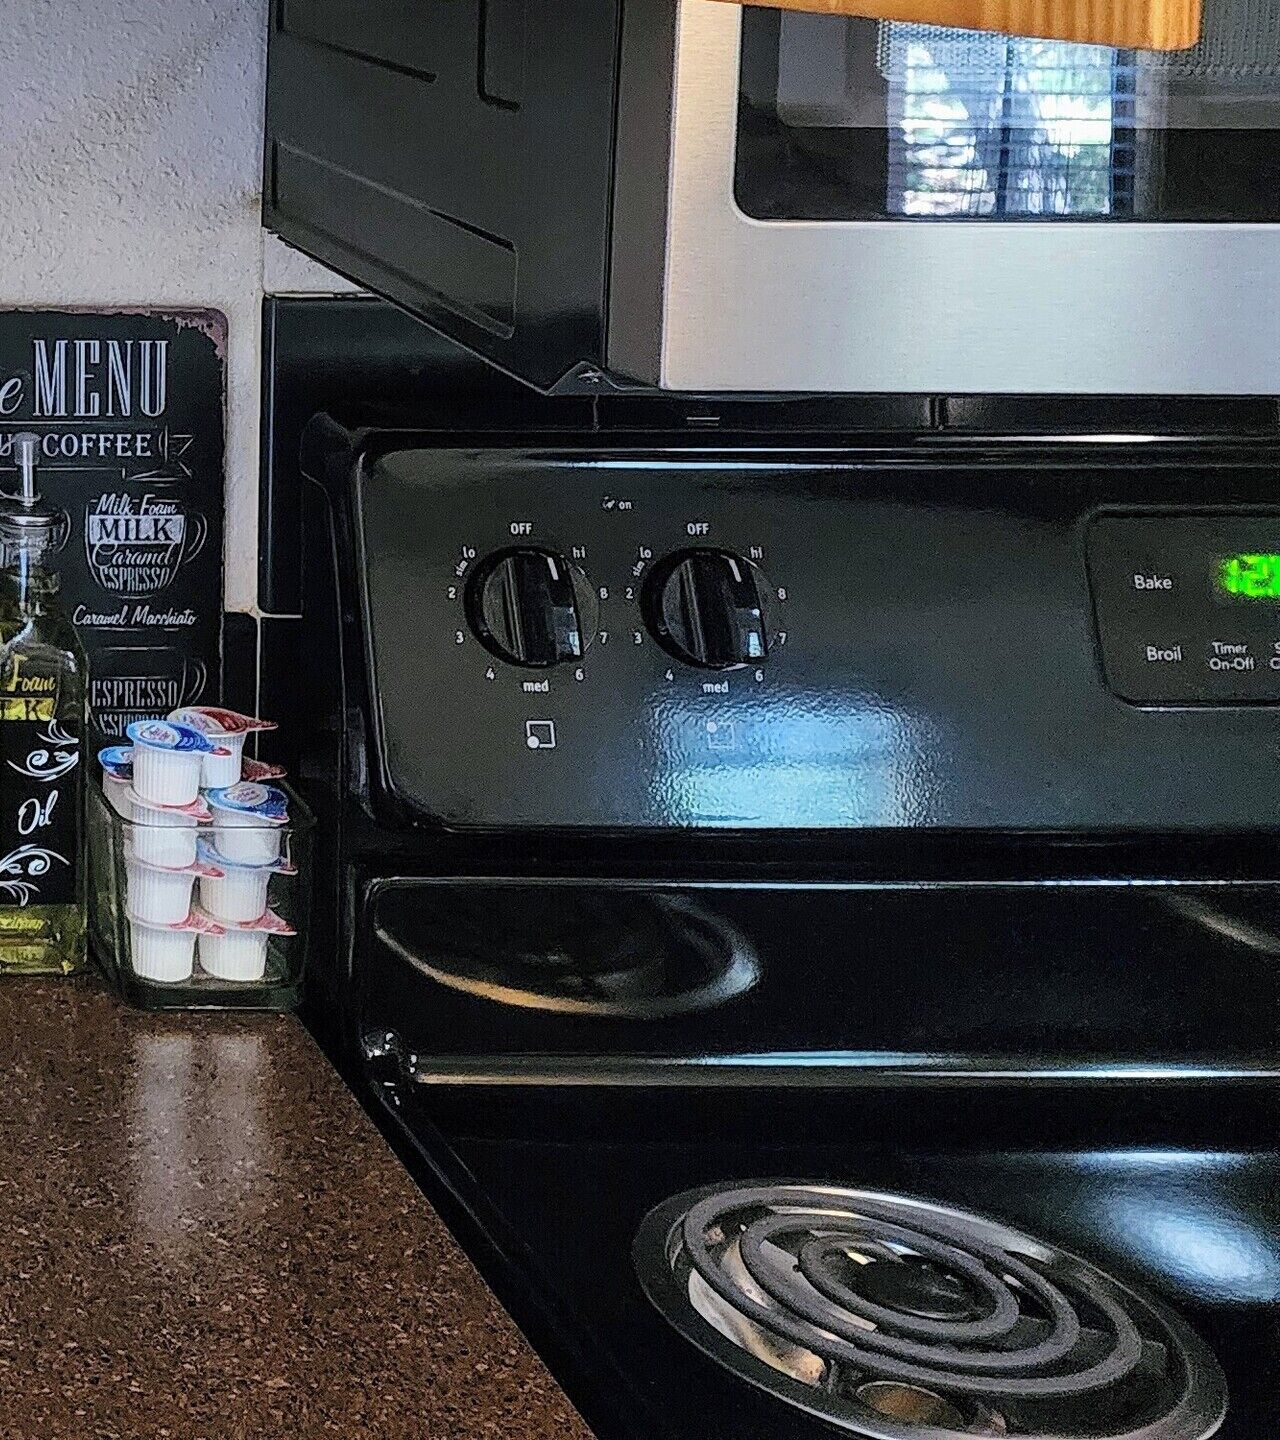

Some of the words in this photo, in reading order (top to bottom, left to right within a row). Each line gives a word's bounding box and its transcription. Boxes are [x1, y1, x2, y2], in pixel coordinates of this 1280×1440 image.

[33, 339, 170, 418] MENU
[42, 433, 152, 458] COFFEE
[96, 493, 133, 515] Milk
[140, 494, 177, 515] Foam
[618, 499, 632, 510] on
[97, 518, 174, 542] MILK
[510, 523, 532, 535] OFF
[687, 523, 709, 535] OFF
[92, 541, 176, 569] Caramel
[463, 546, 475, 559] lo
[573, 547, 585, 559] hi
[639, 547, 652, 559] lo
[750, 547, 763, 559] hi
[99, 567, 171, 591] ESPRESSO
[1134, 574, 1172, 589] Bake
[448, 588, 456, 599] 2
[600, 588, 608, 599] 8
[626, 588, 633, 599] 2
[778, 588, 785, 600] 8
[72, 605, 127, 626] Caramel
[131, 606, 197, 626] Macchiato
[456, 632, 464, 644] 3
[600, 632, 608, 644] 7
[634, 633, 642, 644] 3
[779, 633, 786, 645] 7
[1146, 646, 1182, 661] Broil
[1212, 642, 1248, 654] Timer
[1209, 657, 1254, 671] On-Off
[486, 668, 495, 680] 4
[575, 669, 584, 681] 6
[665, 669, 674, 681] 4
[756, 670, 763, 682] 6
[523, 680, 550, 693] med
[703, 681, 729, 693] med
[91, 680, 178, 707] ESPRESSO
[17, 789, 59, 835] Oil
